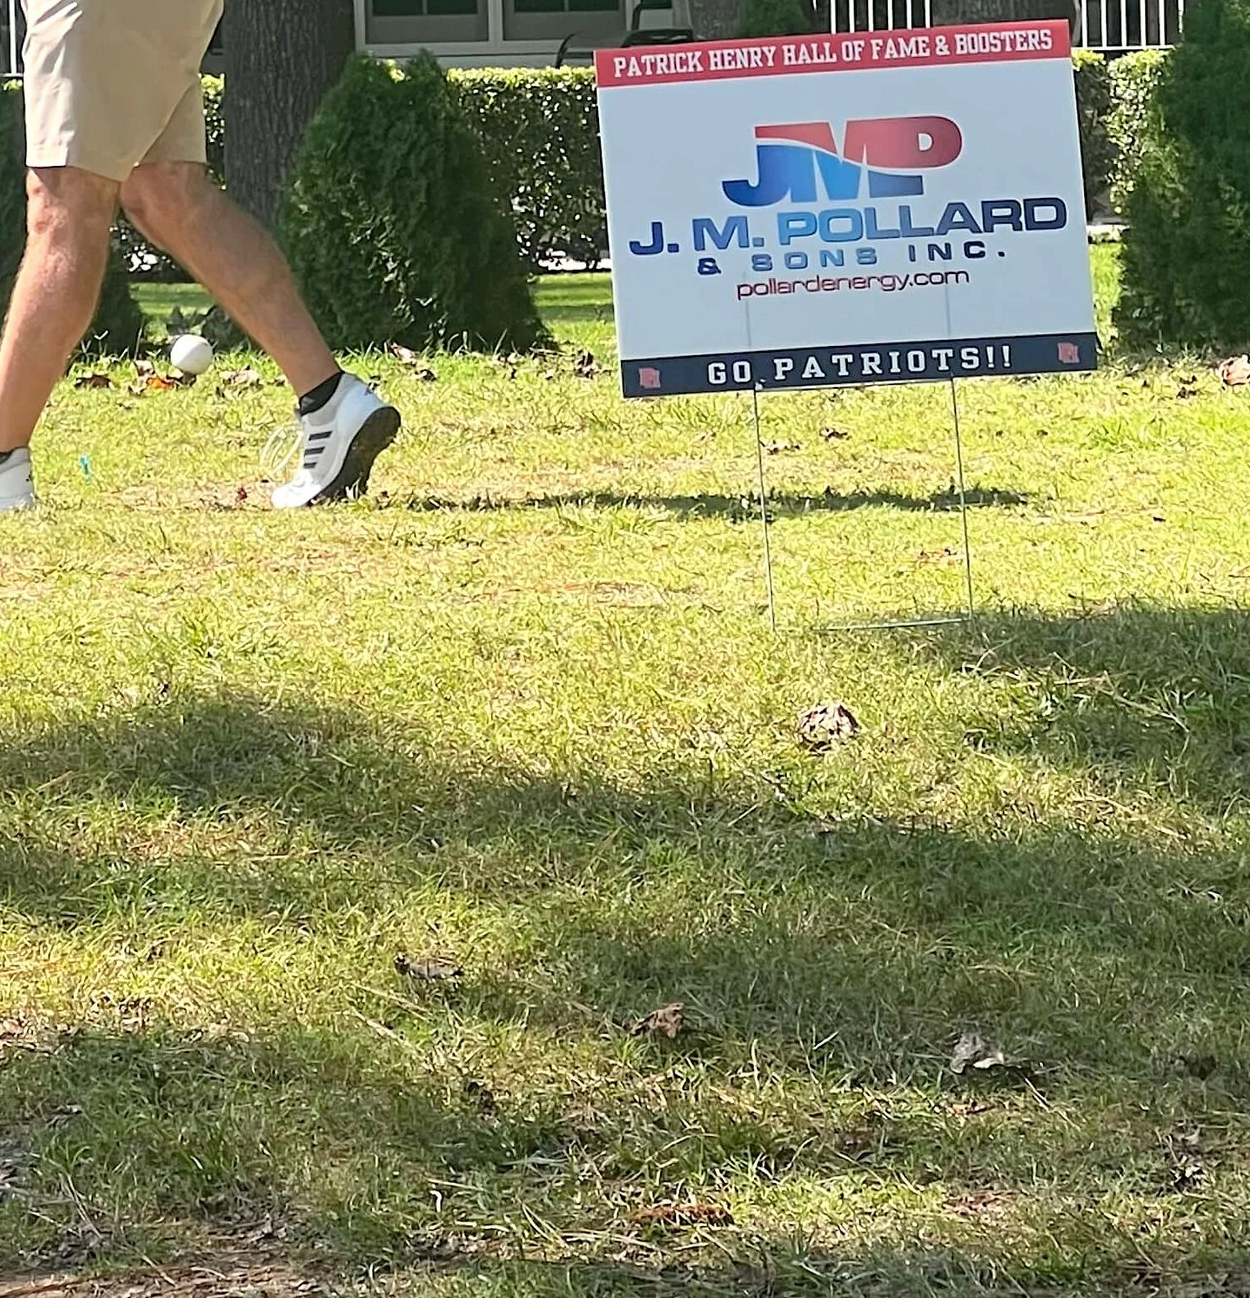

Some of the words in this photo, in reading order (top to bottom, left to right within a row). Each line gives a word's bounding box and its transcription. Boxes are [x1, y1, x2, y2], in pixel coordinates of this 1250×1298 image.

[614, 52, 704, 77] PATRICK
[710, 46, 775, 71] HENRY
[782, 42, 837, 65] HALL
[842, 41, 864, 62] OF
[871, 38, 930, 60] FAME
[936, 36, 950, 56] &
[955, 29, 1052, 55] BOOSTERS
[722, 115, 963, 207] JMP
[778, 198, 1067, 246] POLLARD
[698, 257, 722, 276] &
[752, 248, 878, 272] SONS
[909, 241, 1006, 262] INC.
[737, 270, 970, 301] pollardenergy.com
[708, 361, 751, 385] GO
[774, 346, 1011, 380] PATRIOTS!!
